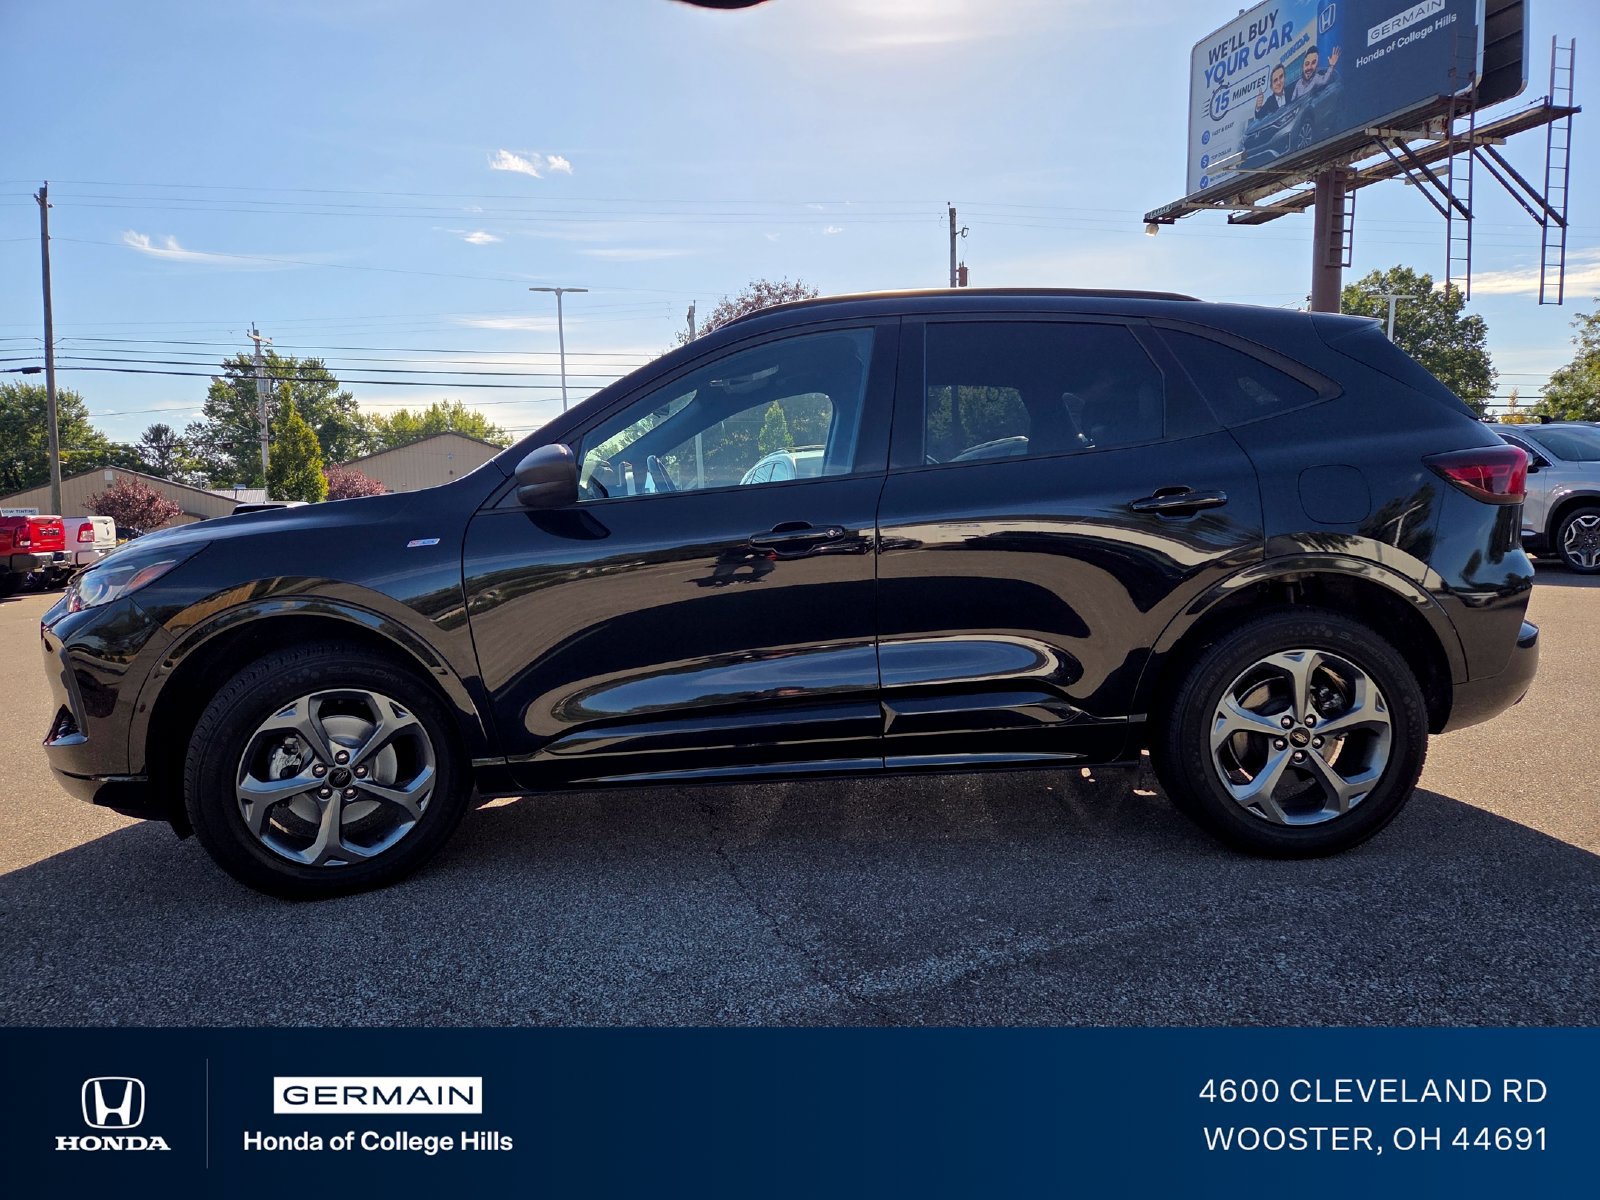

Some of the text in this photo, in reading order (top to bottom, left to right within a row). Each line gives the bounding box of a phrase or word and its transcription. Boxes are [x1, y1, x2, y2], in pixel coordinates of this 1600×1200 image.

[1208, 8, 1280, 66] WE'LL BUY
[1356, 13, 1457, 68] Honda of College Hills
[1370, 0, 1443, 40] GERMAIN
[1203, 20, 1294, 89] YOUR CAR
[1214, 75, 1267, 114] 15 MINUTES
